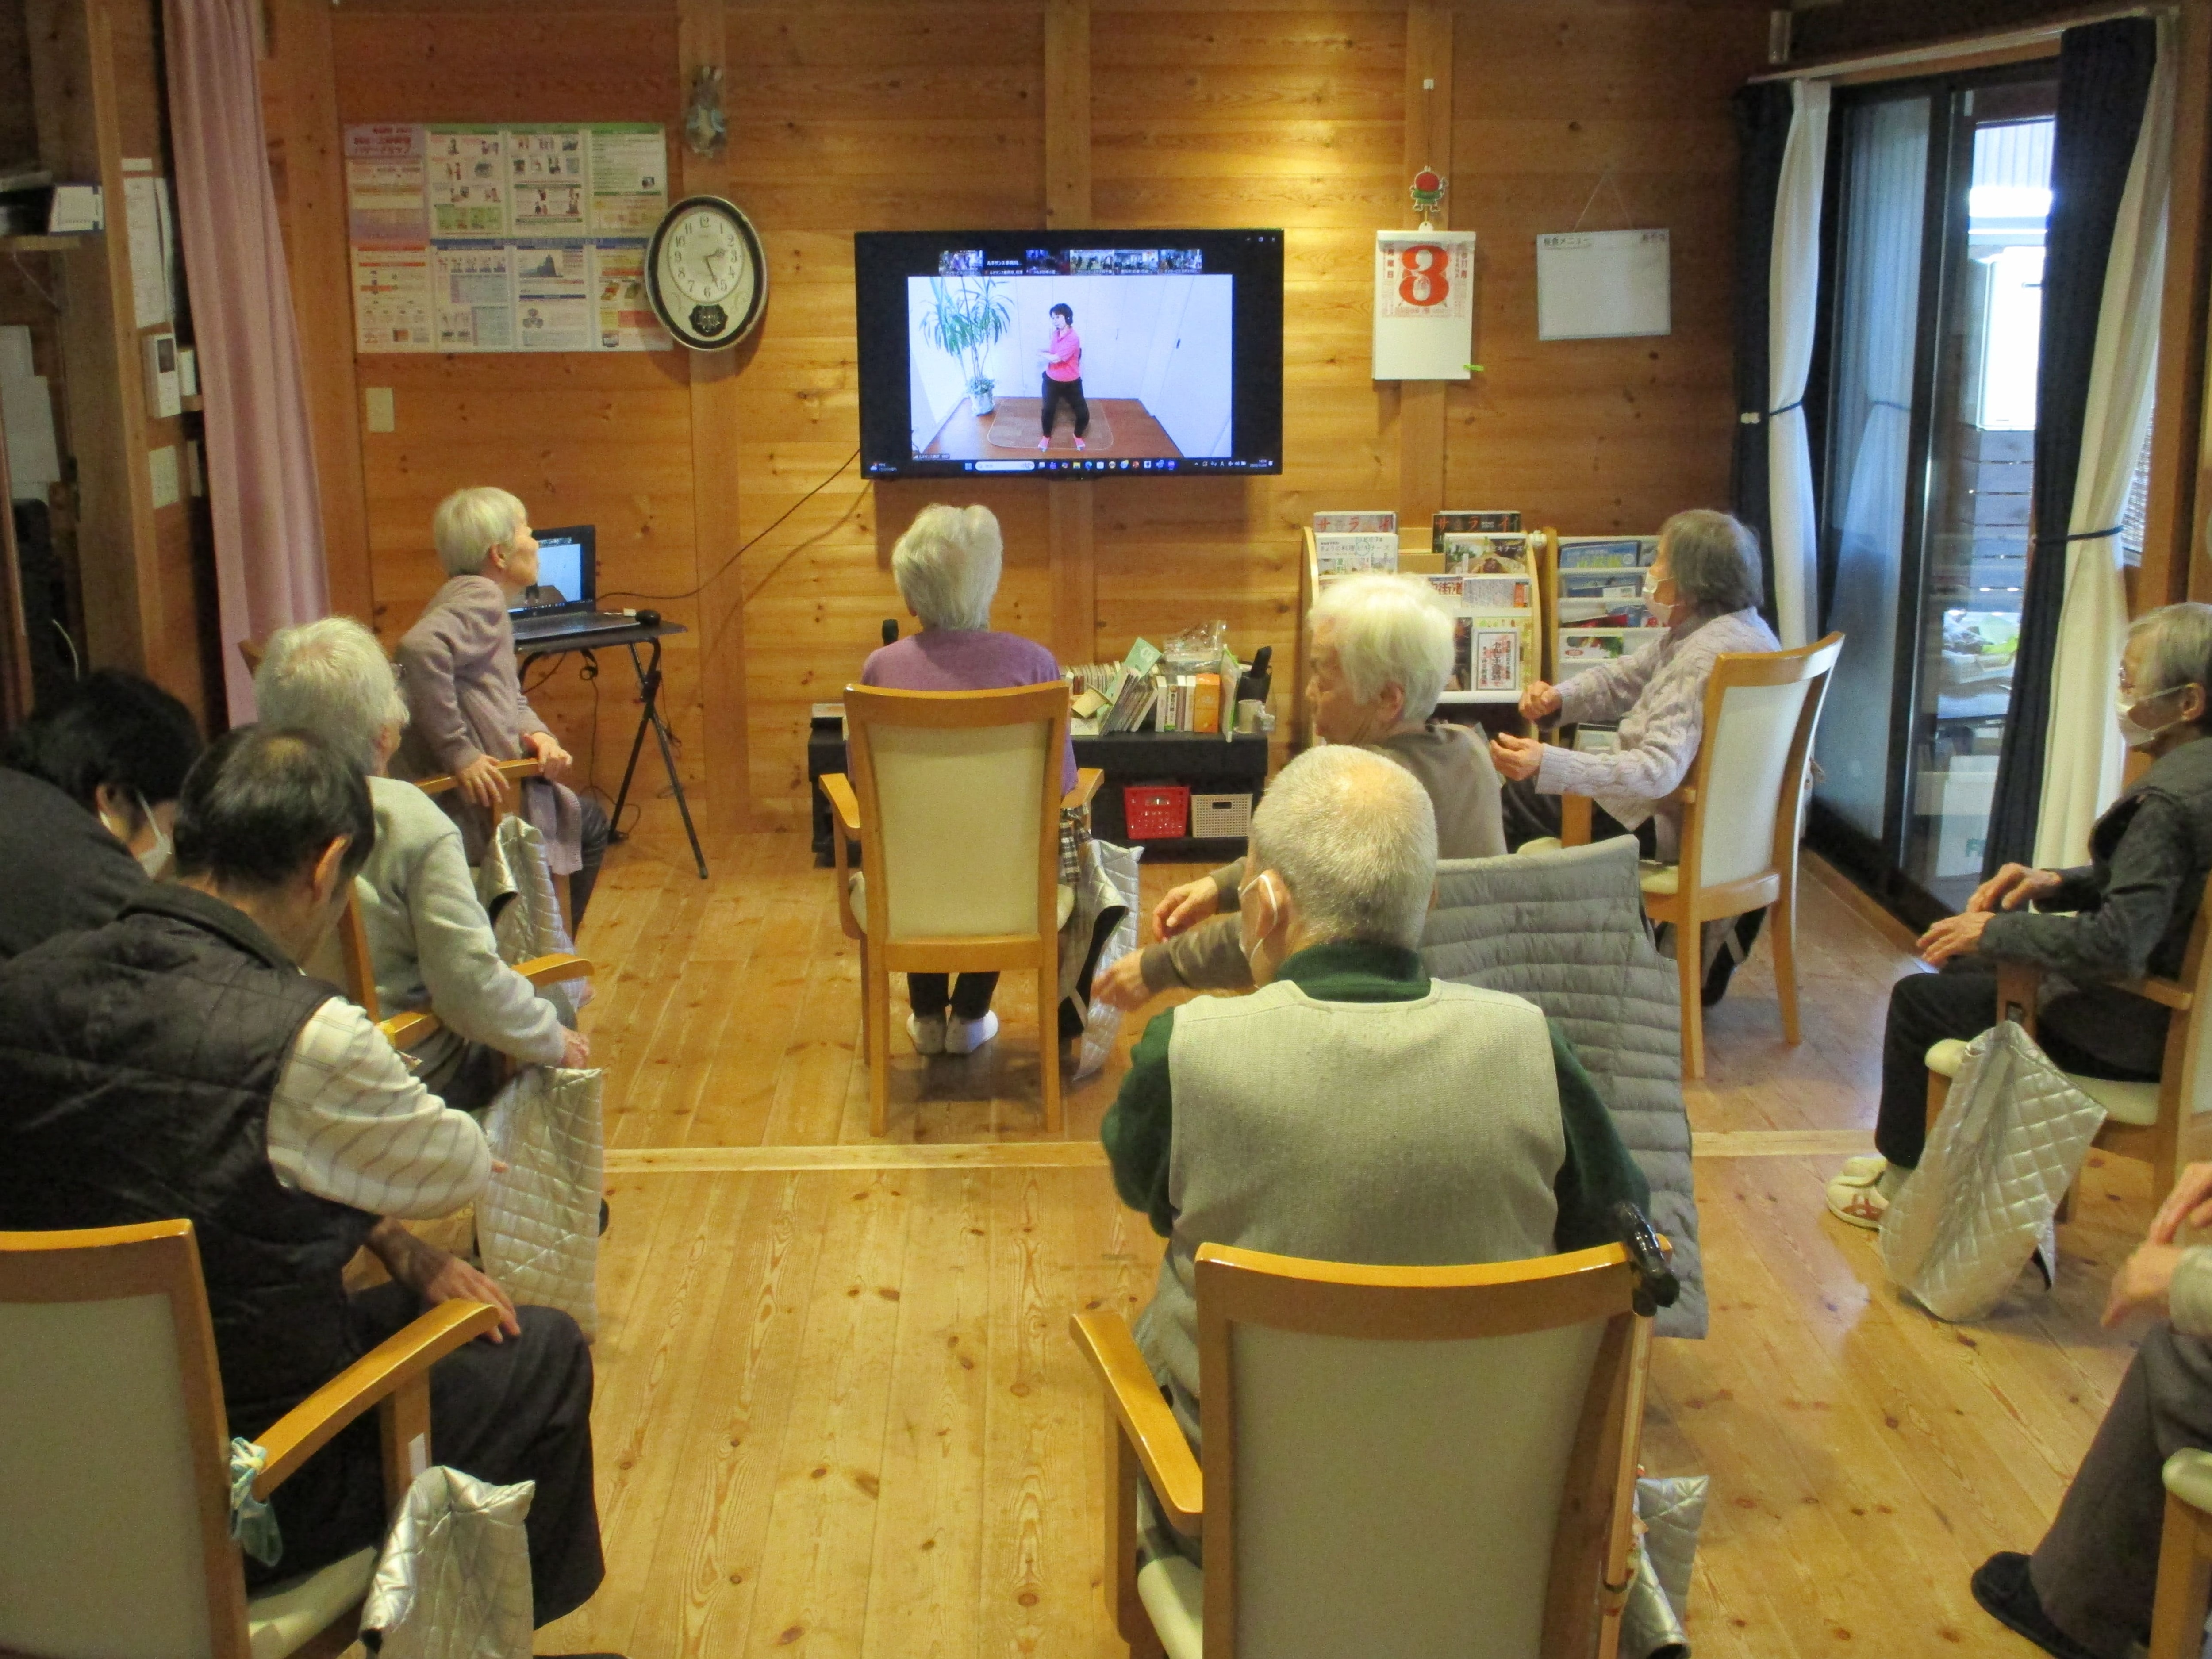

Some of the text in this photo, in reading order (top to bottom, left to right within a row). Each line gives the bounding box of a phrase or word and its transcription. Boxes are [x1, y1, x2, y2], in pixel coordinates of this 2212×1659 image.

[685, 222, 692, 234] 11
[699, 216, 709, 228] 12
[720, 222, 723, 234] 1
[676, 235, 685, 248] 10
[728, 235, 734, 247] 2
[675, 251, 682, 263] 9
[730, 250, 737, 263] 3
[678, 267, 685, 280] 8
[729, 266, 735, 279] 4
[1398, 244, 1450, 307] 8
[687, 279, 695, 292] 7
[720, 279, 727, 291] 5
[703, 287, 710, 298] 6
[1436, 515, 1509, 533] サライ
